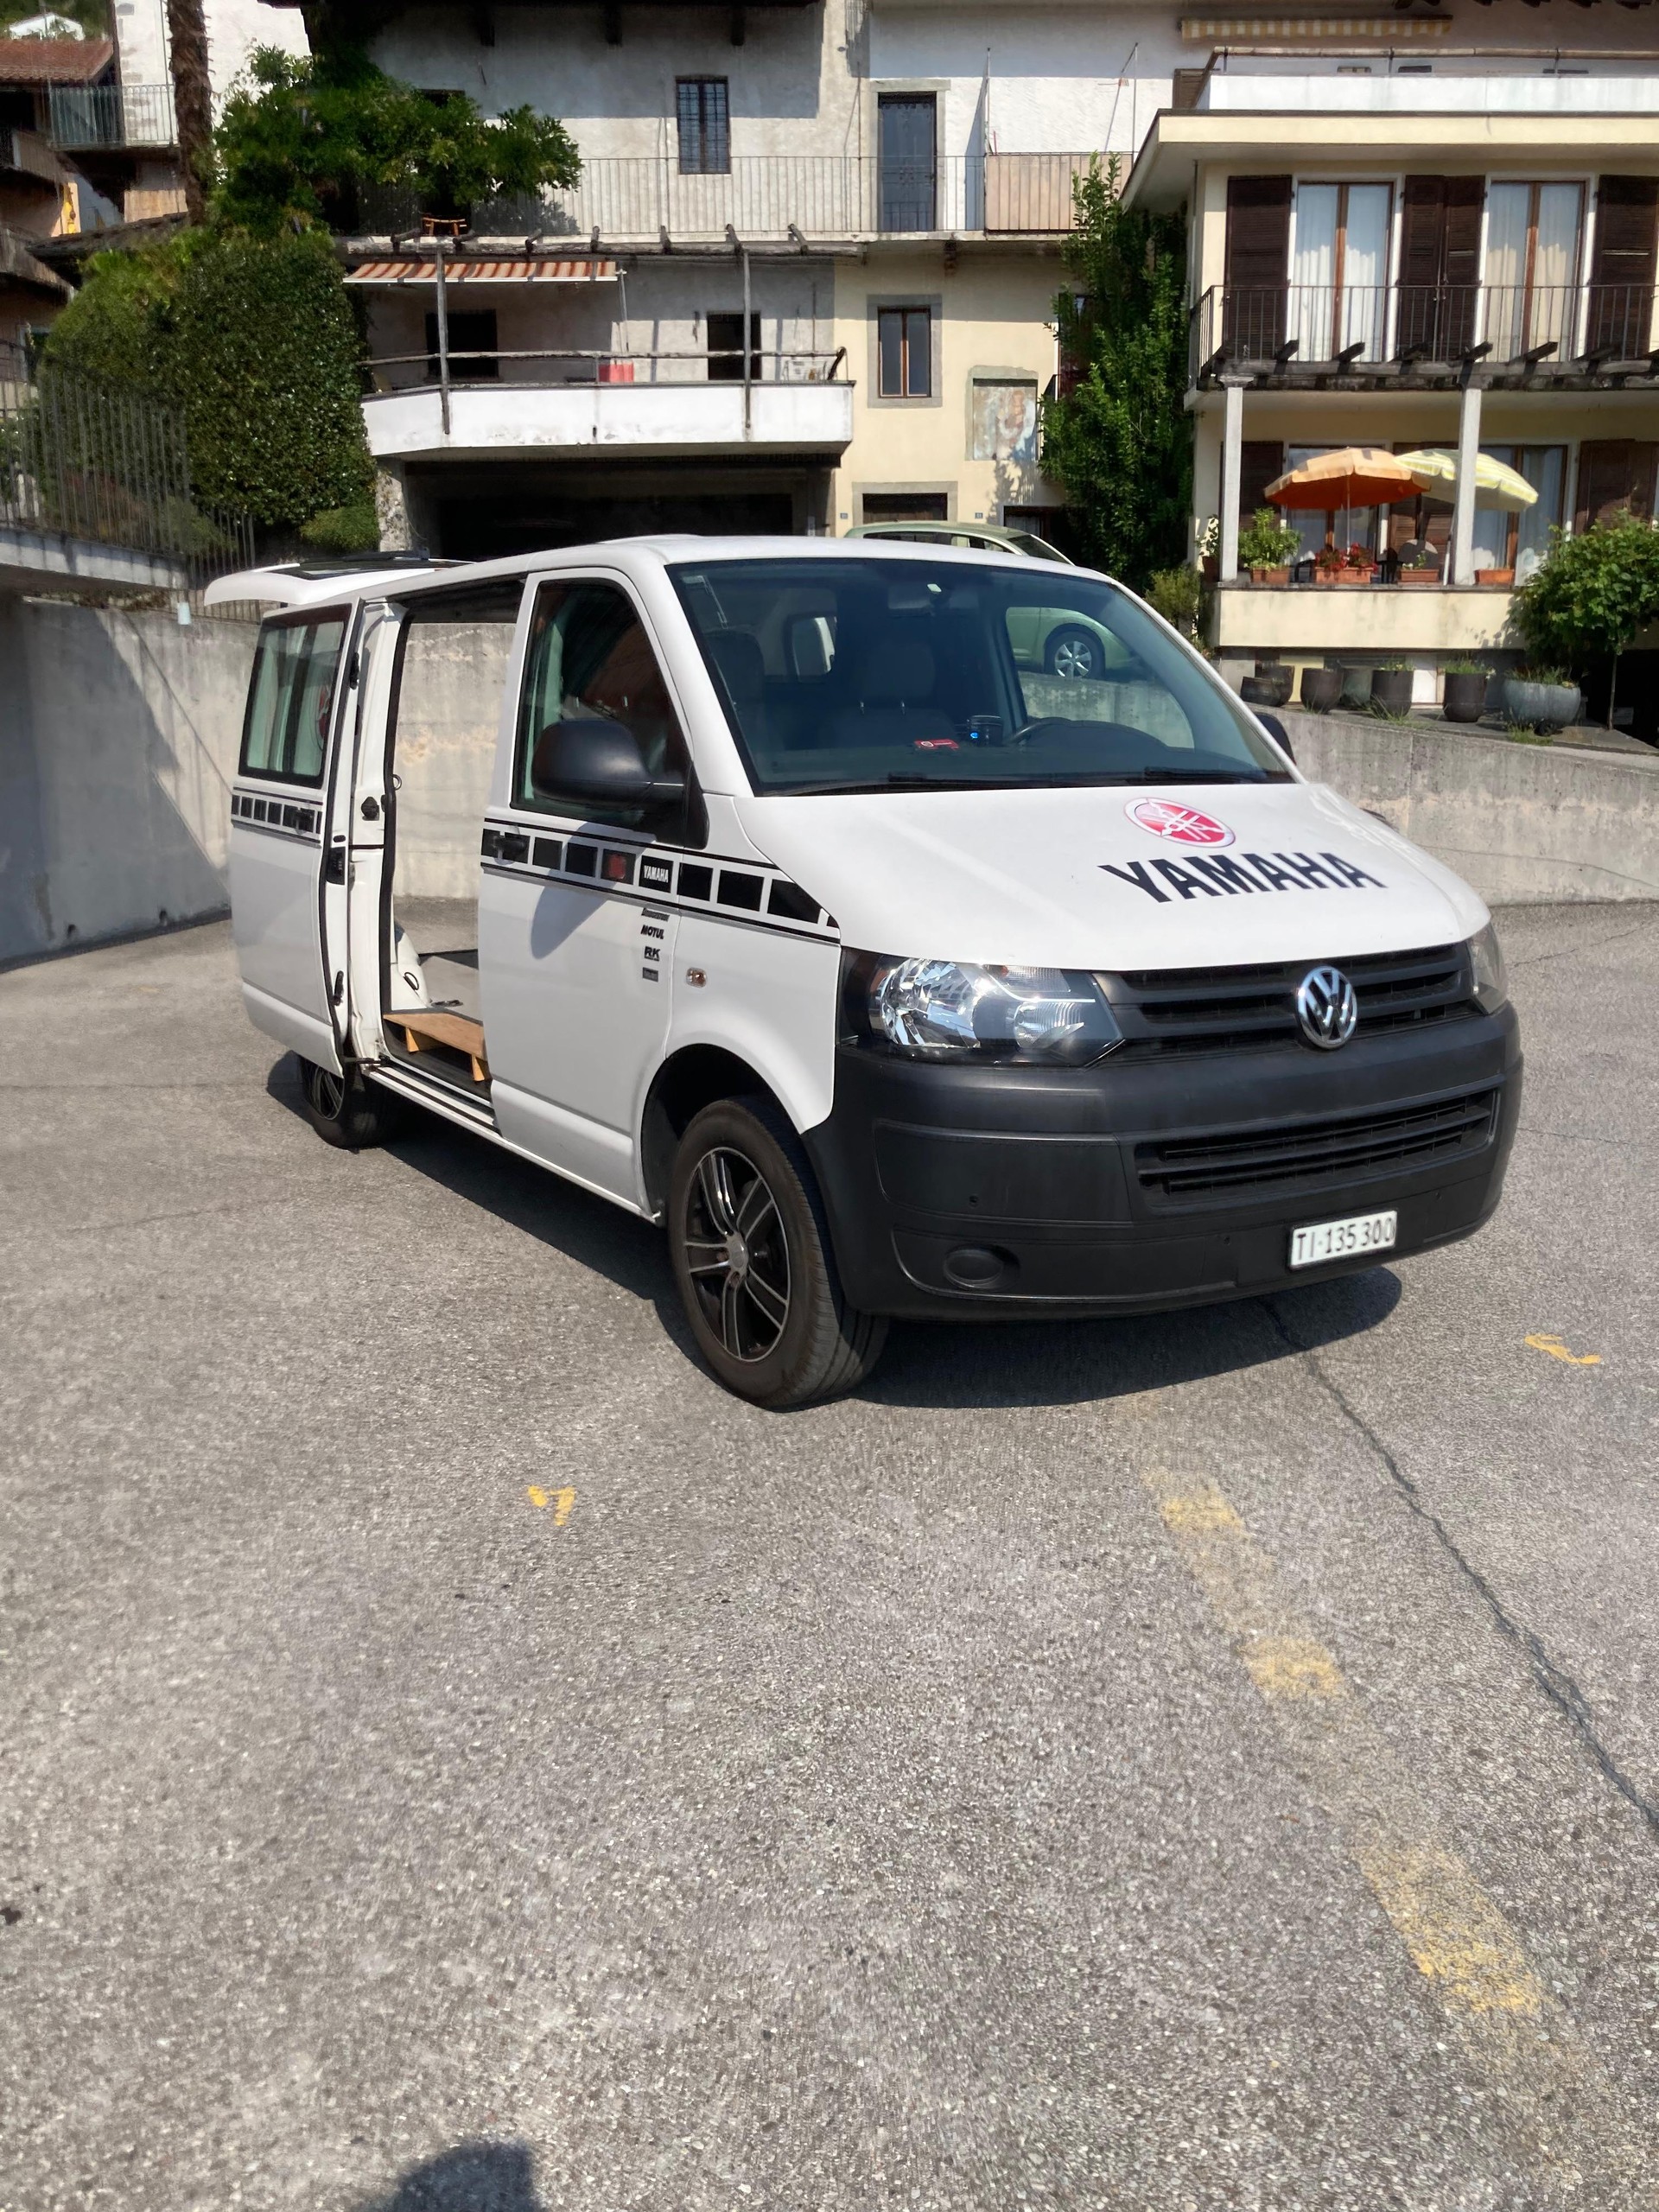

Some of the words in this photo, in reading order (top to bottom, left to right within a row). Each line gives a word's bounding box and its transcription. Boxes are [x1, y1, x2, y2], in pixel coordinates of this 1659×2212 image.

[644, 865, 669, 883] YAMAHA
[1097, 852, 1388, 903] YAMAHA
[640, 925, 664, 939] MOTUL
[645, 946, 660, 959] RK
